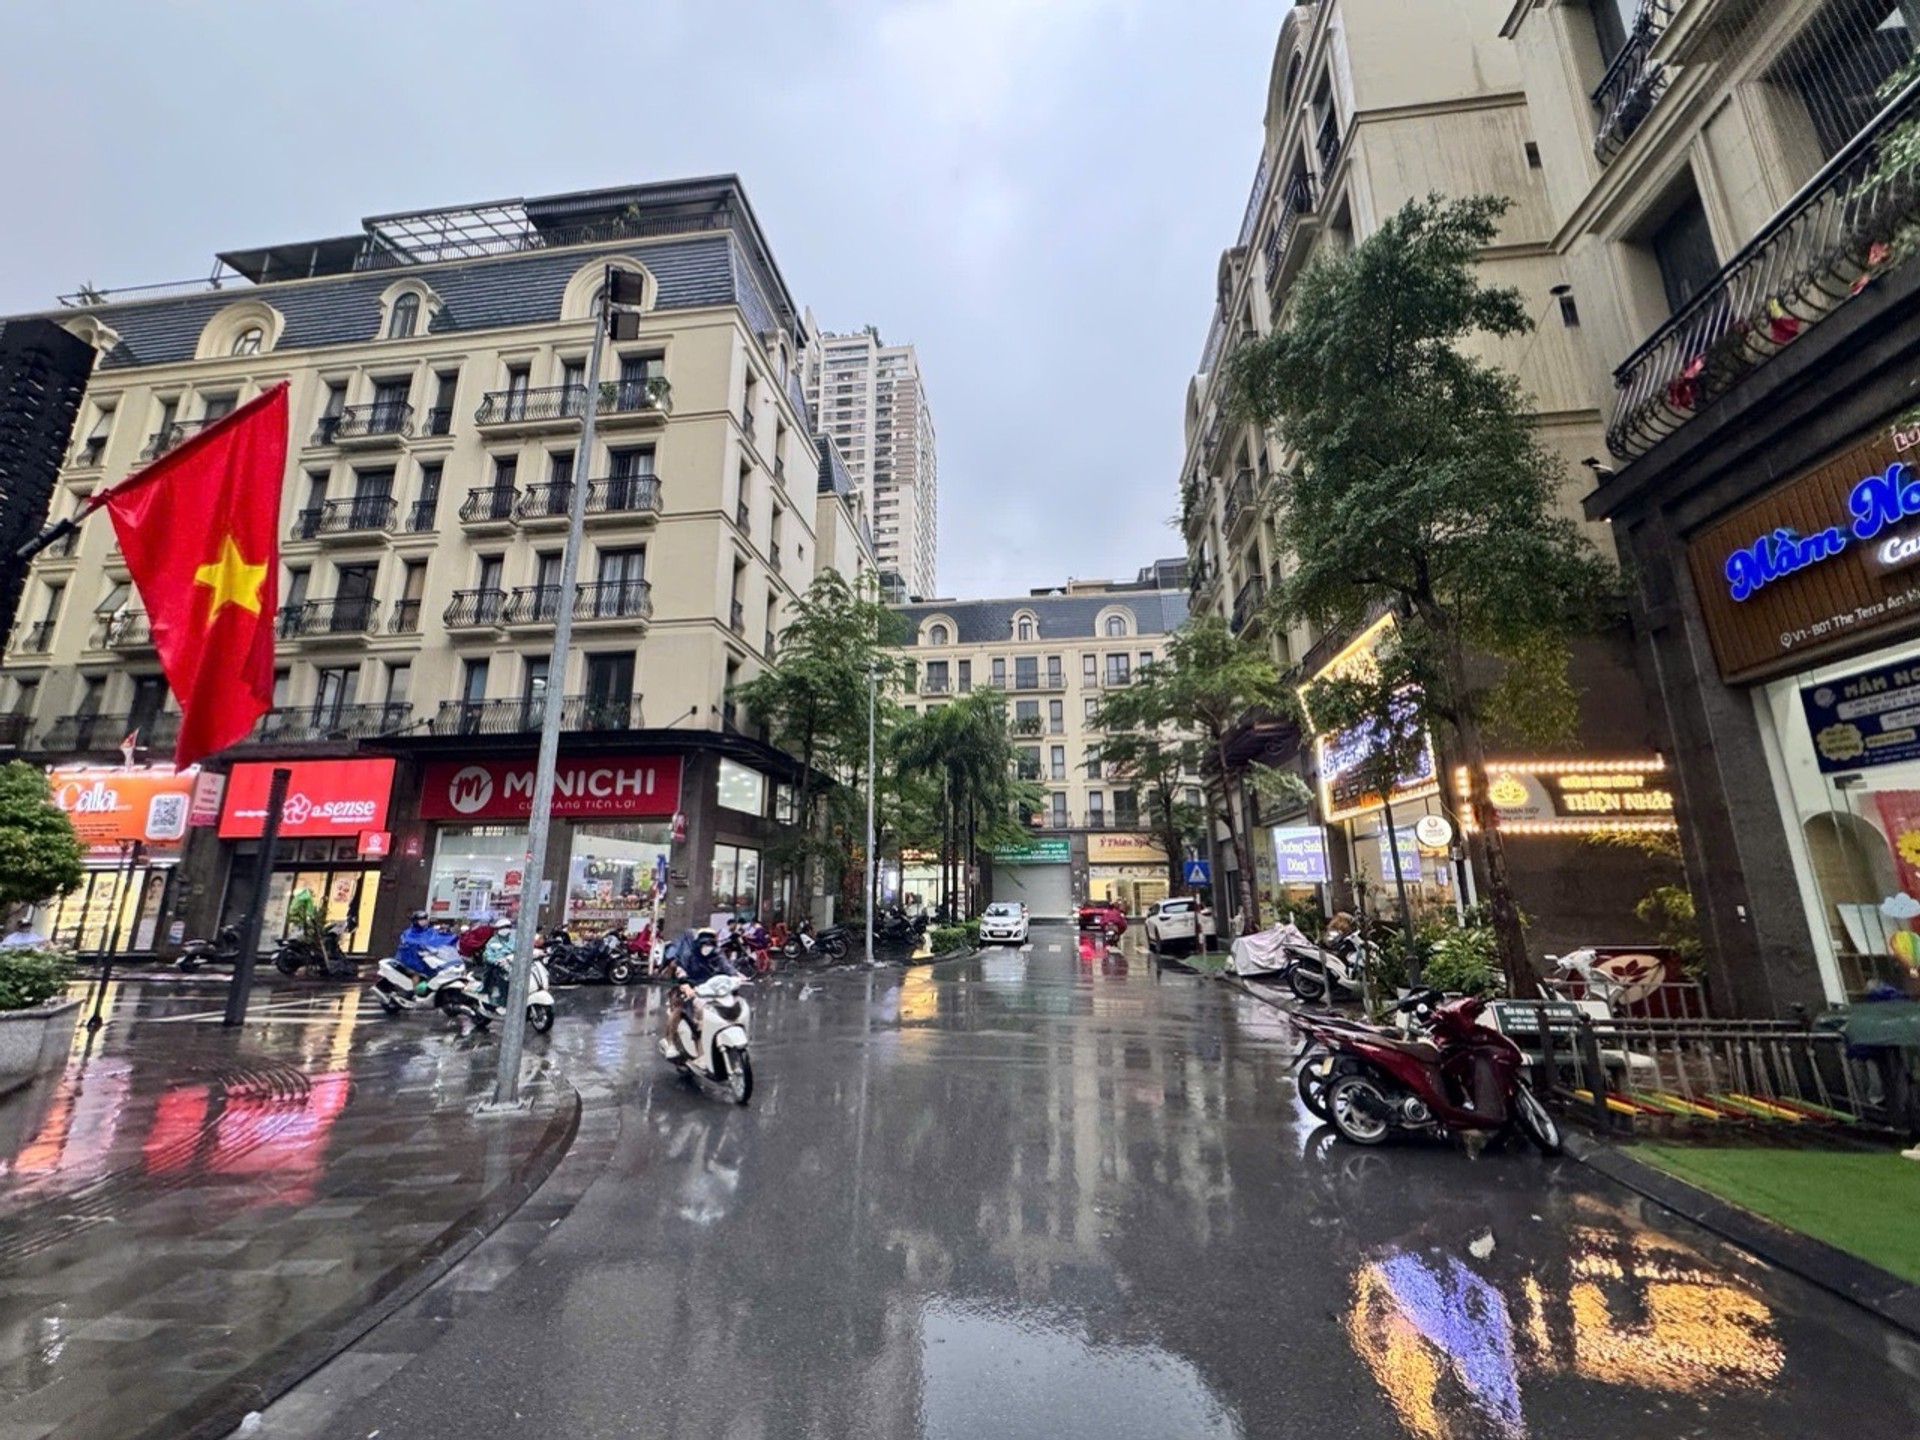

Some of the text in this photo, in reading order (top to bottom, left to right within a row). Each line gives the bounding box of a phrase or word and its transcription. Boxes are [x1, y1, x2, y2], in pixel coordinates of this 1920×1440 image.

[1725, 527, 1847, 602] Mầm
[1831, 613, 1854, 628] The
[1854, 603, 1885, 619] Terra
[503, 769, 656, 799] MNICHI
